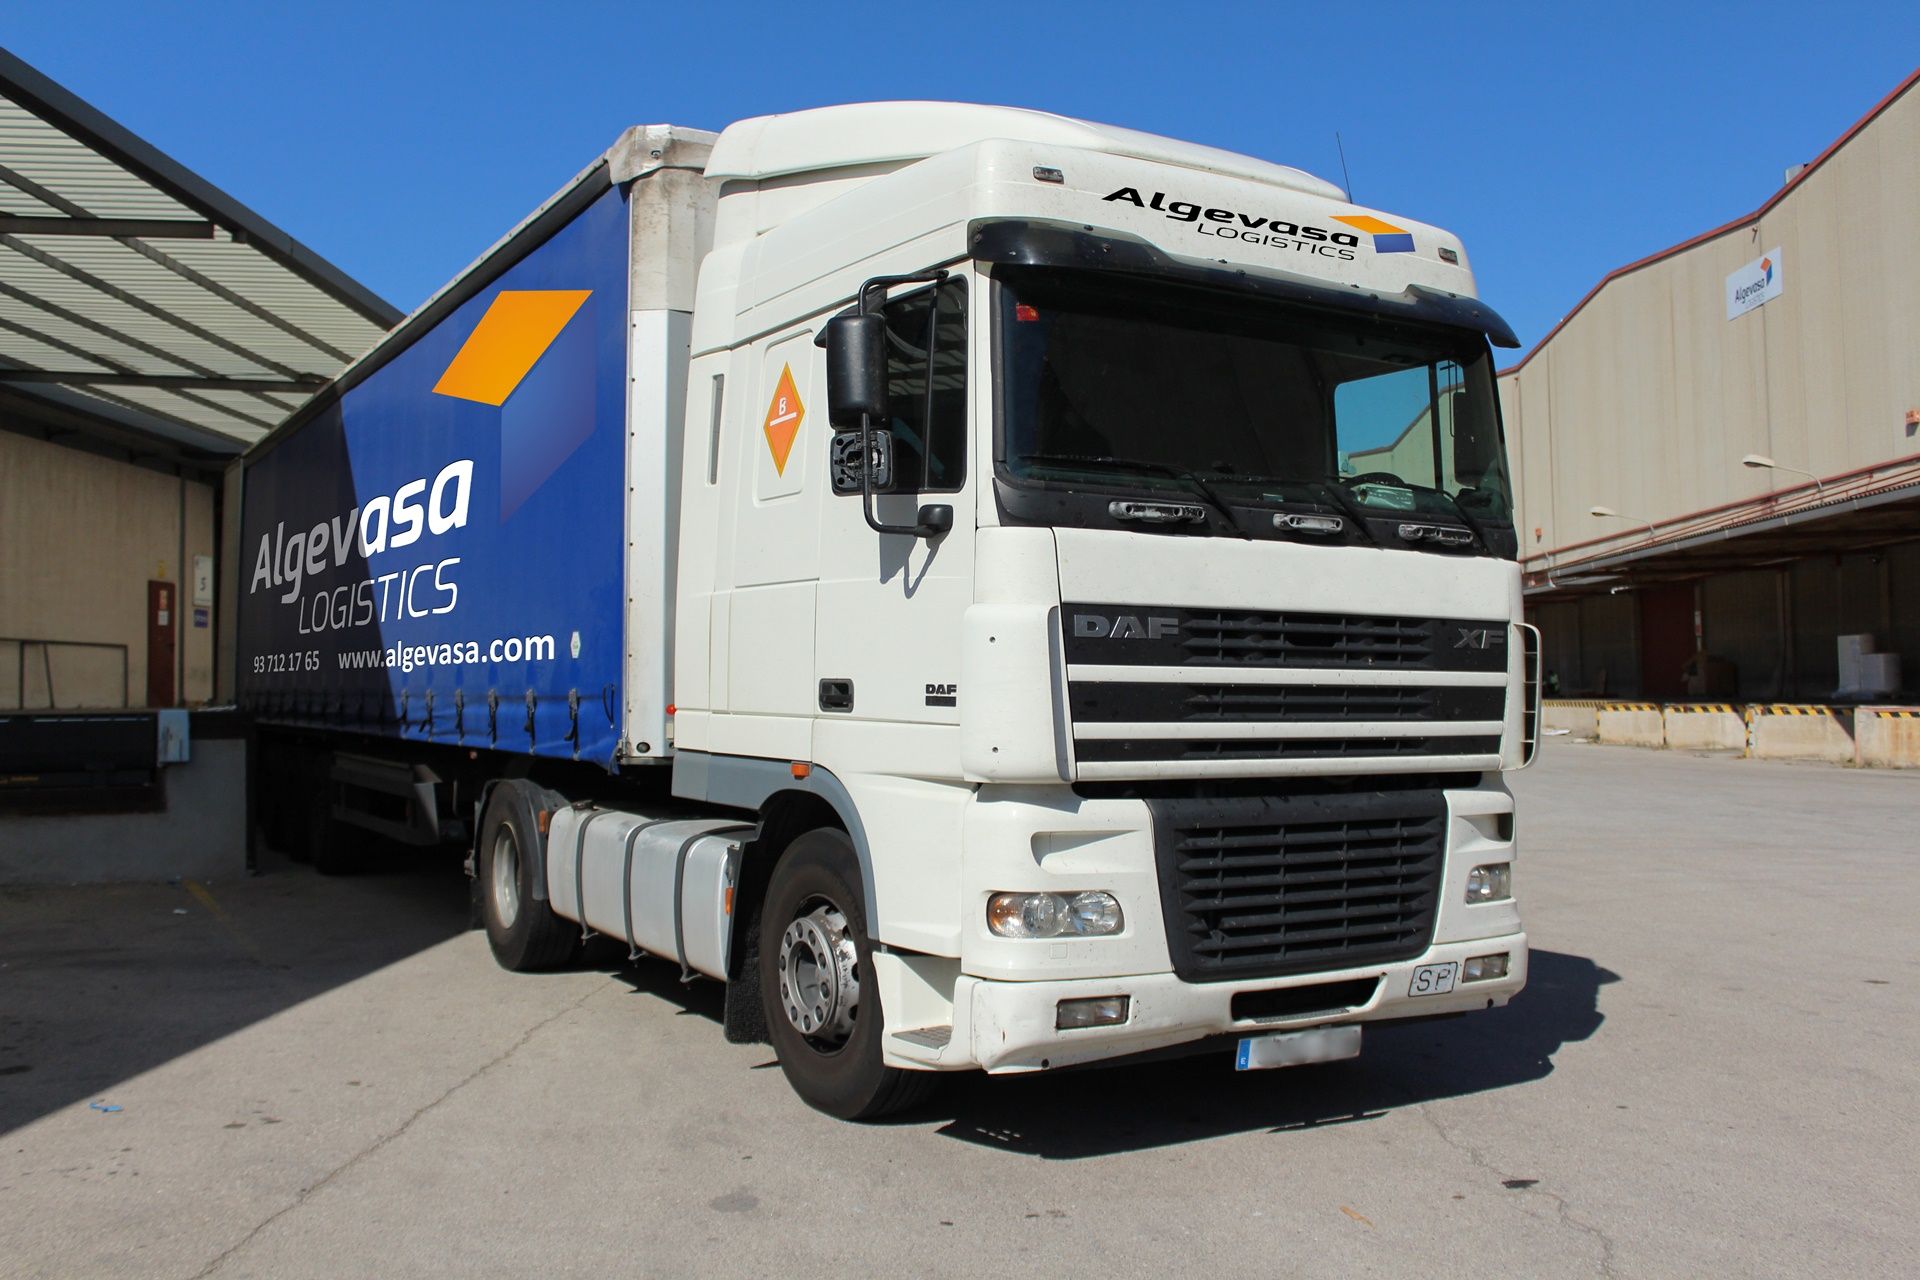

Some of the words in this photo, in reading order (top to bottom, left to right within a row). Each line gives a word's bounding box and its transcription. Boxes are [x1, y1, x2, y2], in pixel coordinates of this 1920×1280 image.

[1102, 187, 1359, 248] Algevasa
[1197, 223, 1356, 261] LOGISTICS
[1735, 278, 1765, 304] Algevasa
[249, 459, 475, 604] Algevasa
[298, 557, 461, 634] LOGISTICS
[1074, 614, 1179, 639] DAF
[1453, 628, 1505, 649] XF
[253, 656, 265, 673] 93
[267, 654, 286, 672] 712
[288, 652, 302, 671] 17
[304, 650, 320, 671] 65
[338, 634, 555, 673] www.algevasa.com
[925, 684, 957, 695] DAF
[1416, 968, 1451, 992] SP
